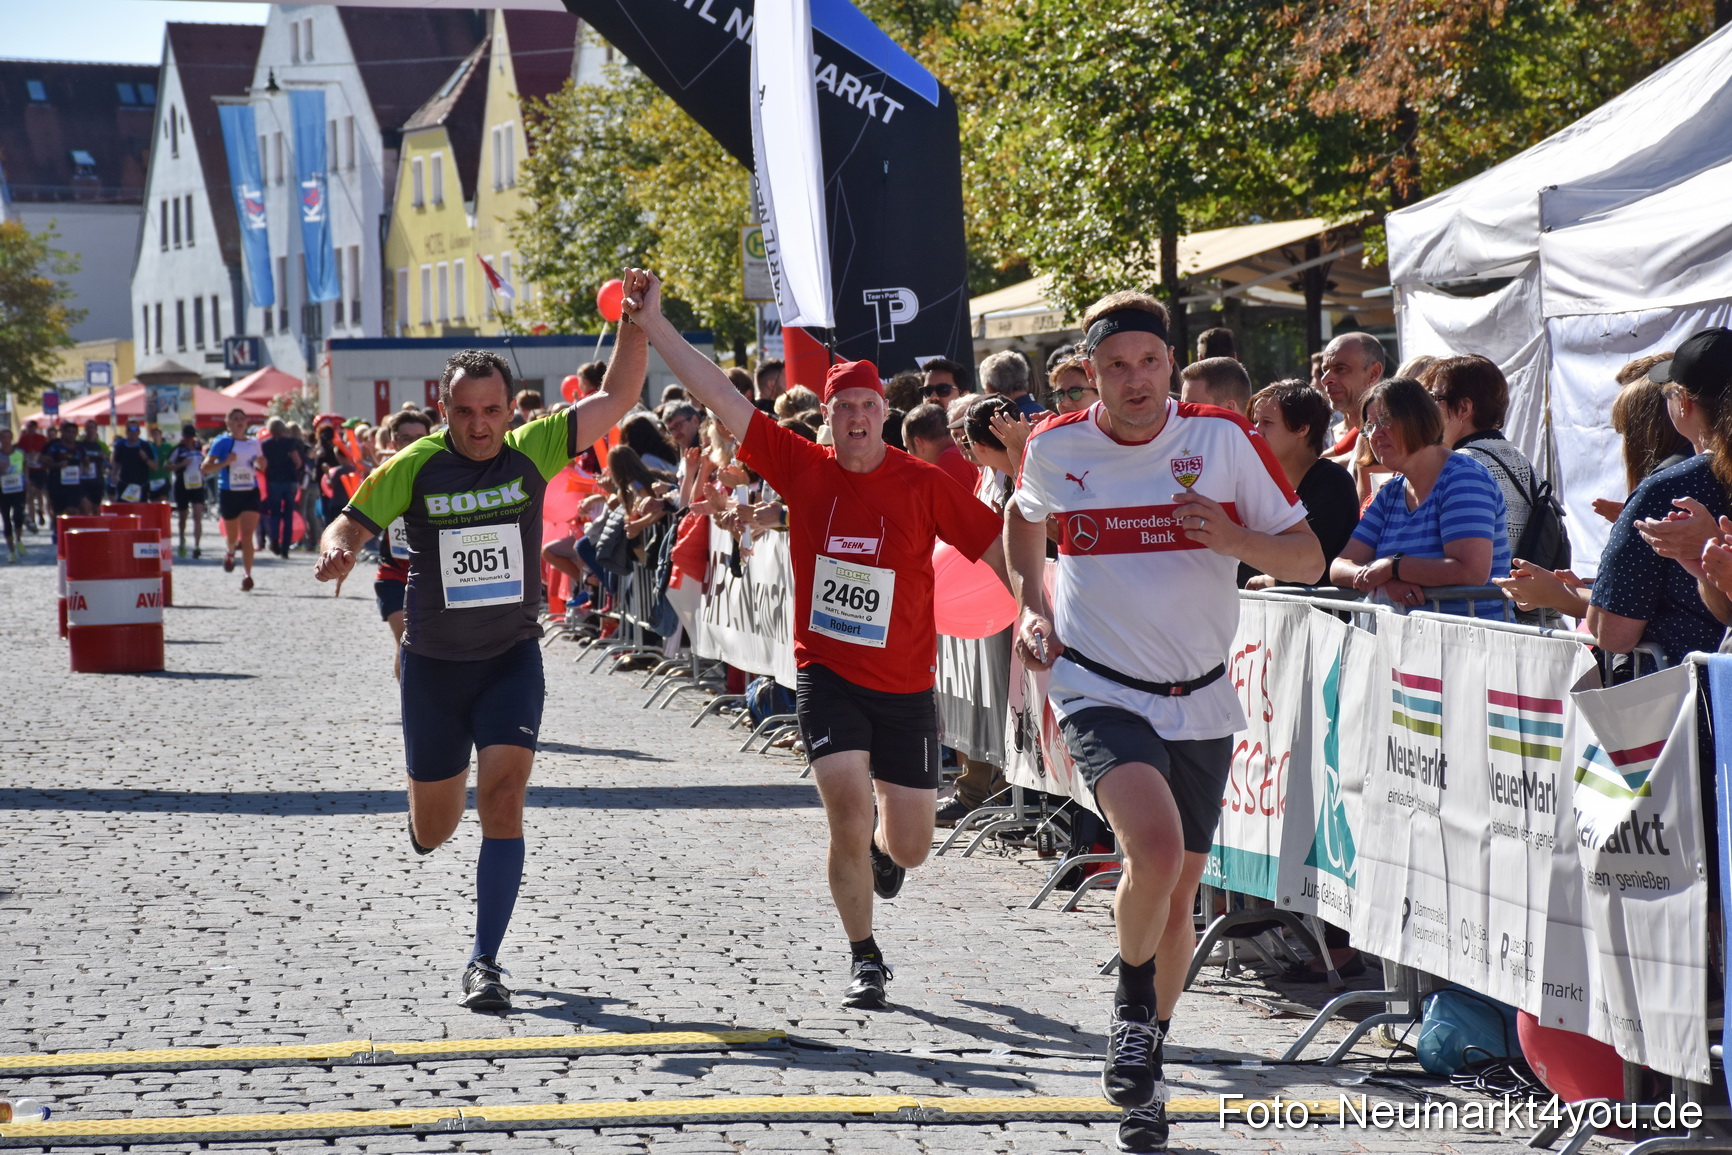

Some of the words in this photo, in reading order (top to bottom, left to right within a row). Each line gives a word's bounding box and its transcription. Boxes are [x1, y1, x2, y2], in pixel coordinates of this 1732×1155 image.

[425, 479, 527, 516] BOCK
[427, 517, 459, 526] inspired
[460, 516, 472, 524] by
[473, 510, 498, 521] smart
[499, 500, 533, 515] concepts
[1105, 514, 1191, 531] Mercedes-B
[462, 532, 499, 544] BOCK
[841, 541, 865, 549] DEHN
[1140, 530, 1177, 545] Bank
[452, 546, 509, 575] 3051
[478, 574, 503, 582] Neumarkt
[836, 566, 871, 582] BOCK
[822, 579, 880, 613] 2469
[825, 606, 840, 615] PARTL
[840, 610, 865, 621] Neumarkt
[830, 618, 862, 635] Robert
[1616, 870, 1670, 892] genießen
